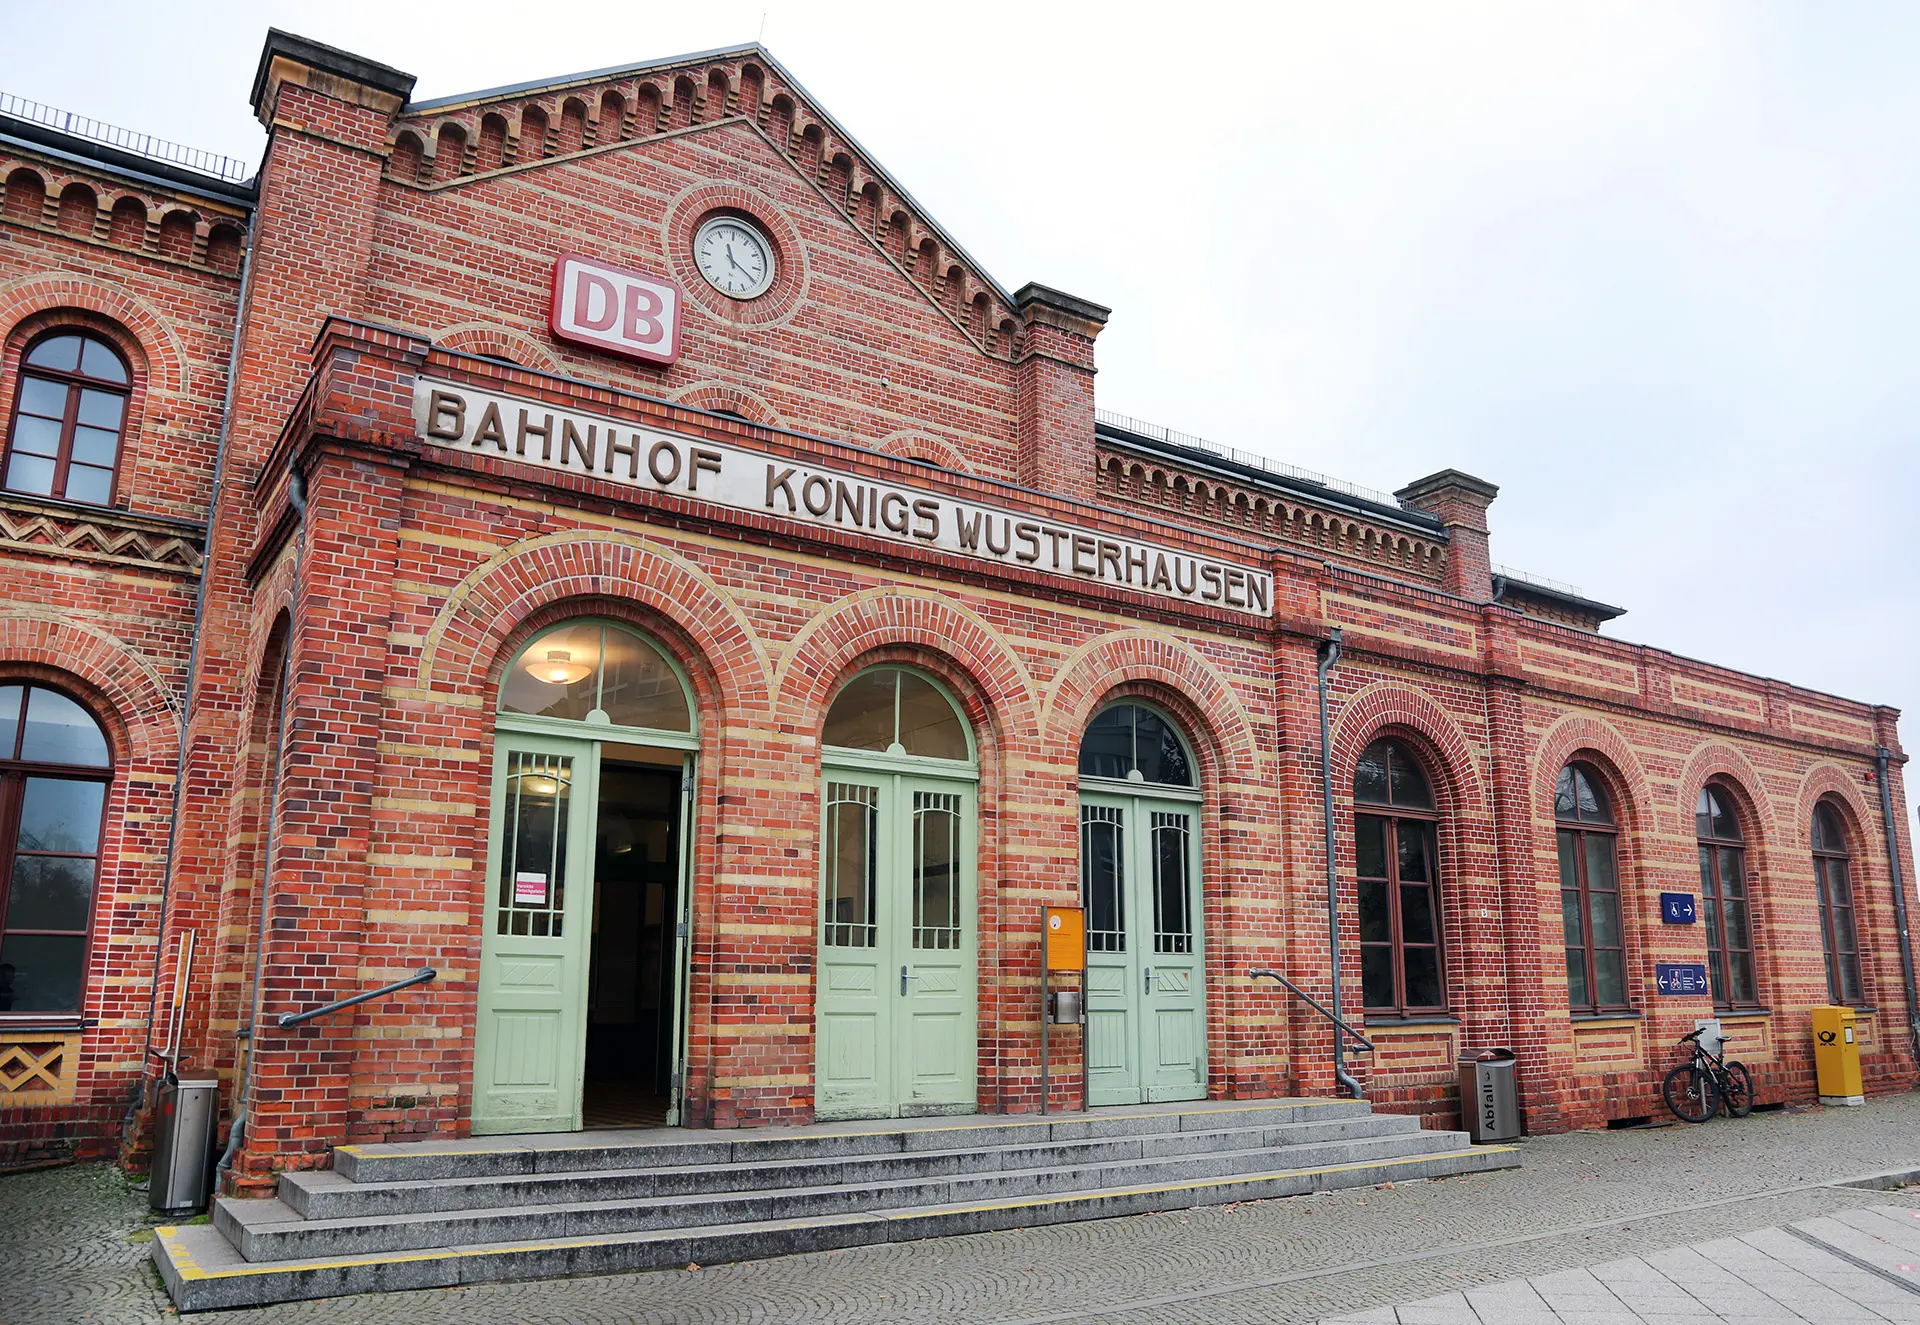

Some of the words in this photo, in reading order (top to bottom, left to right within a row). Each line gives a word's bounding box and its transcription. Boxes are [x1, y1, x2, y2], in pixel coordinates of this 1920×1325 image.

[573, 270, 664, 345] DB
[427, 388, 722, 491] BAHNHOF
[765, 464, 940, 541] KÖNIGS
[956, 507, 1268, 611] WUSTERHAUSEN
[1483, 1084, 1496, 1131] Abfall
